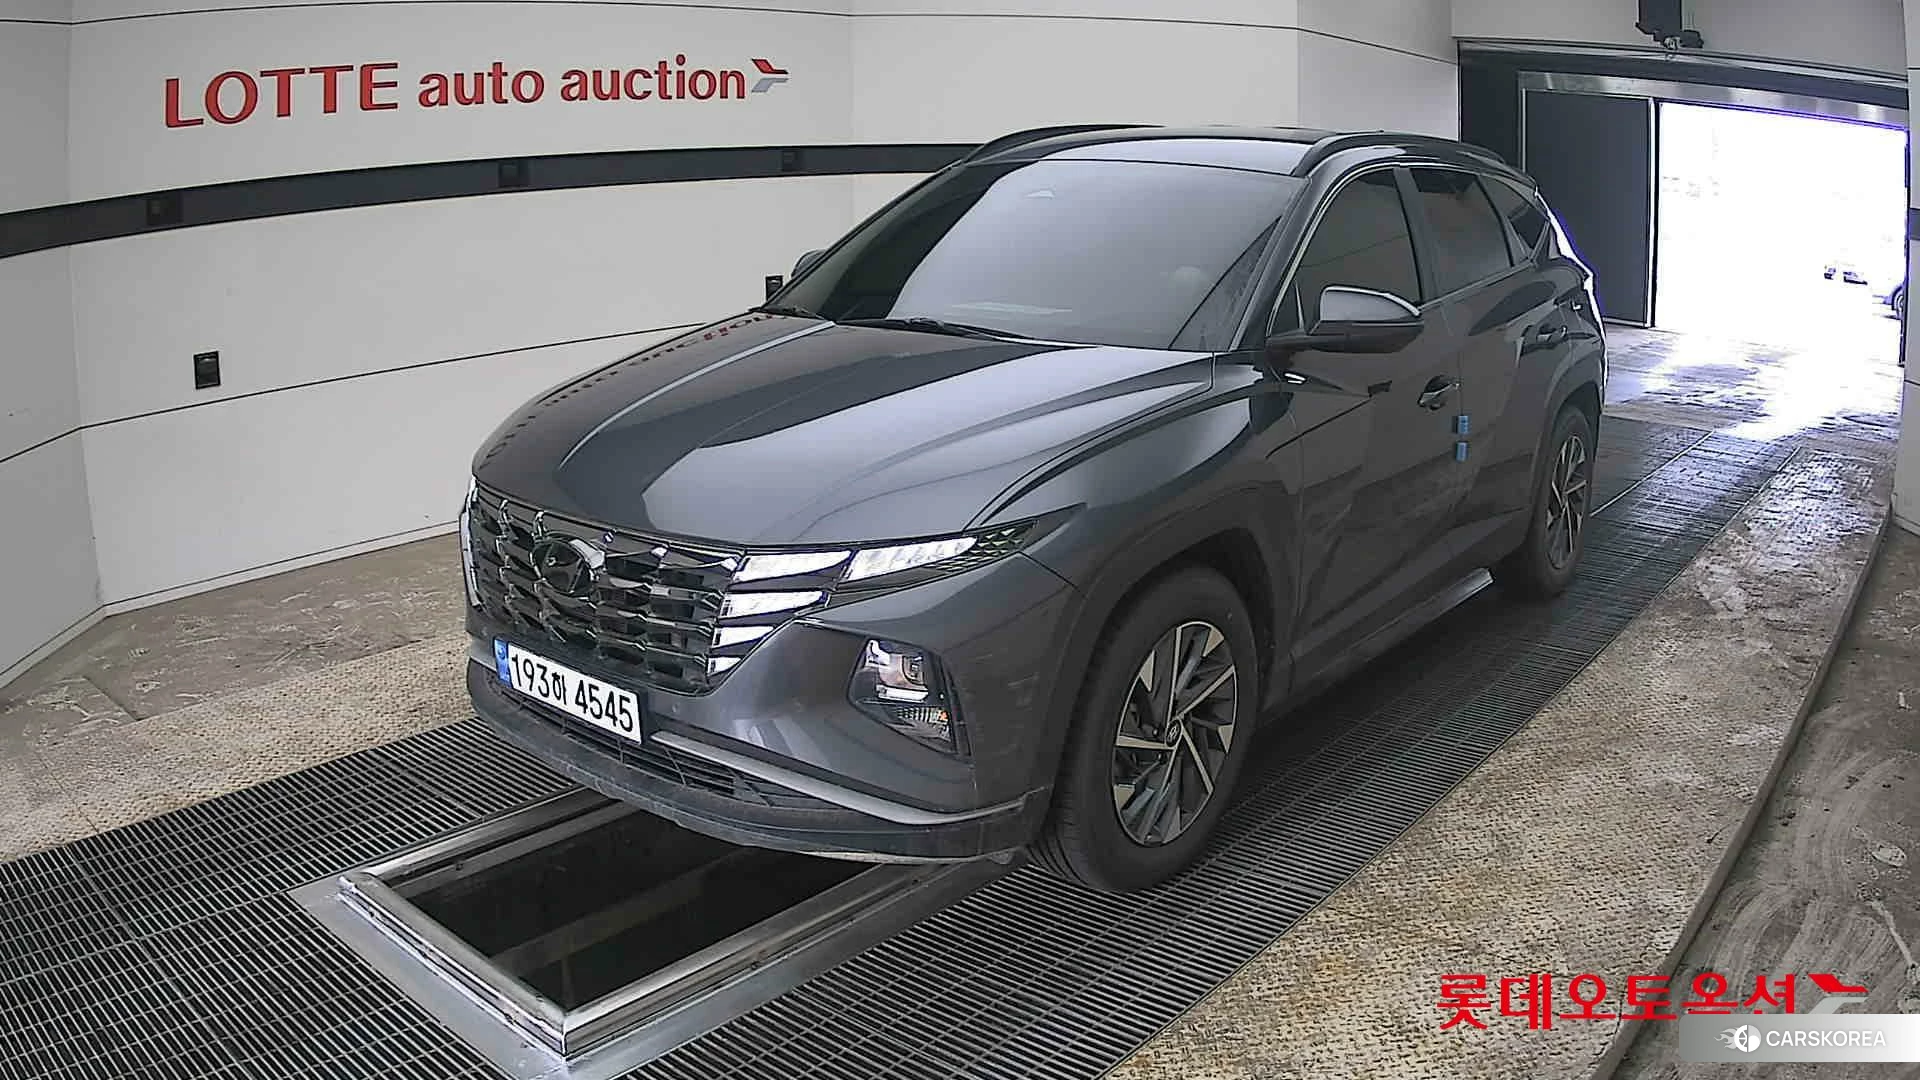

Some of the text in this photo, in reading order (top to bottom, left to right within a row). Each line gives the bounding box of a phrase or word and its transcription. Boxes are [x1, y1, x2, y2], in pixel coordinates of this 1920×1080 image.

[165, 54, 746, 128] LOTTE auto auction
[511, 653, 633, 733] 193하 4545
